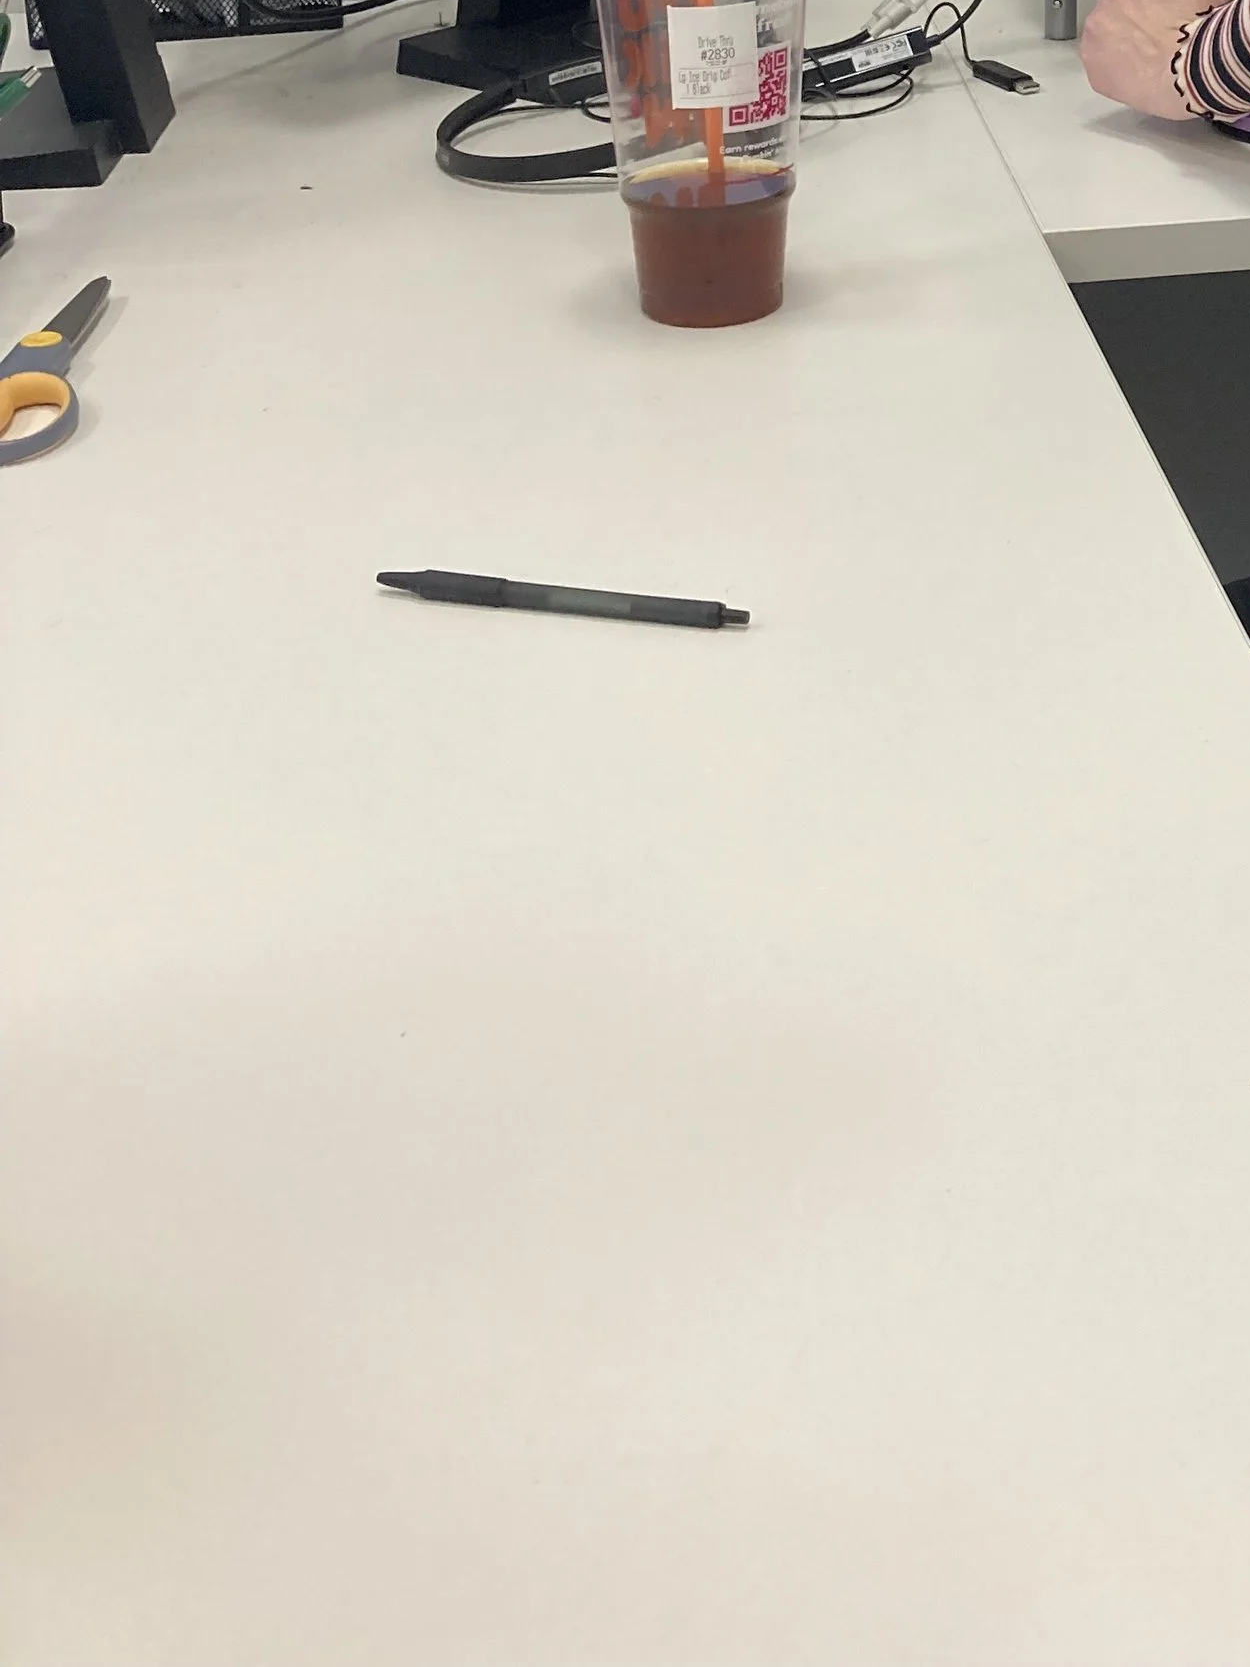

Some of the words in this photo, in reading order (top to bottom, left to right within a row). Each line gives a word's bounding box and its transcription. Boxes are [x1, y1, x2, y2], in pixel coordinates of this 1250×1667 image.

[698, 36, 717, 48] Drive
[720, 34, 734, 46] Thru
[701, 47, 736, 61] #2830
[689, 70, 700, 83] Ice
[702, 70, 718, 84] Orig
[692, 82, 712, 95] Black
[720, 146, 742, 155] Earn
